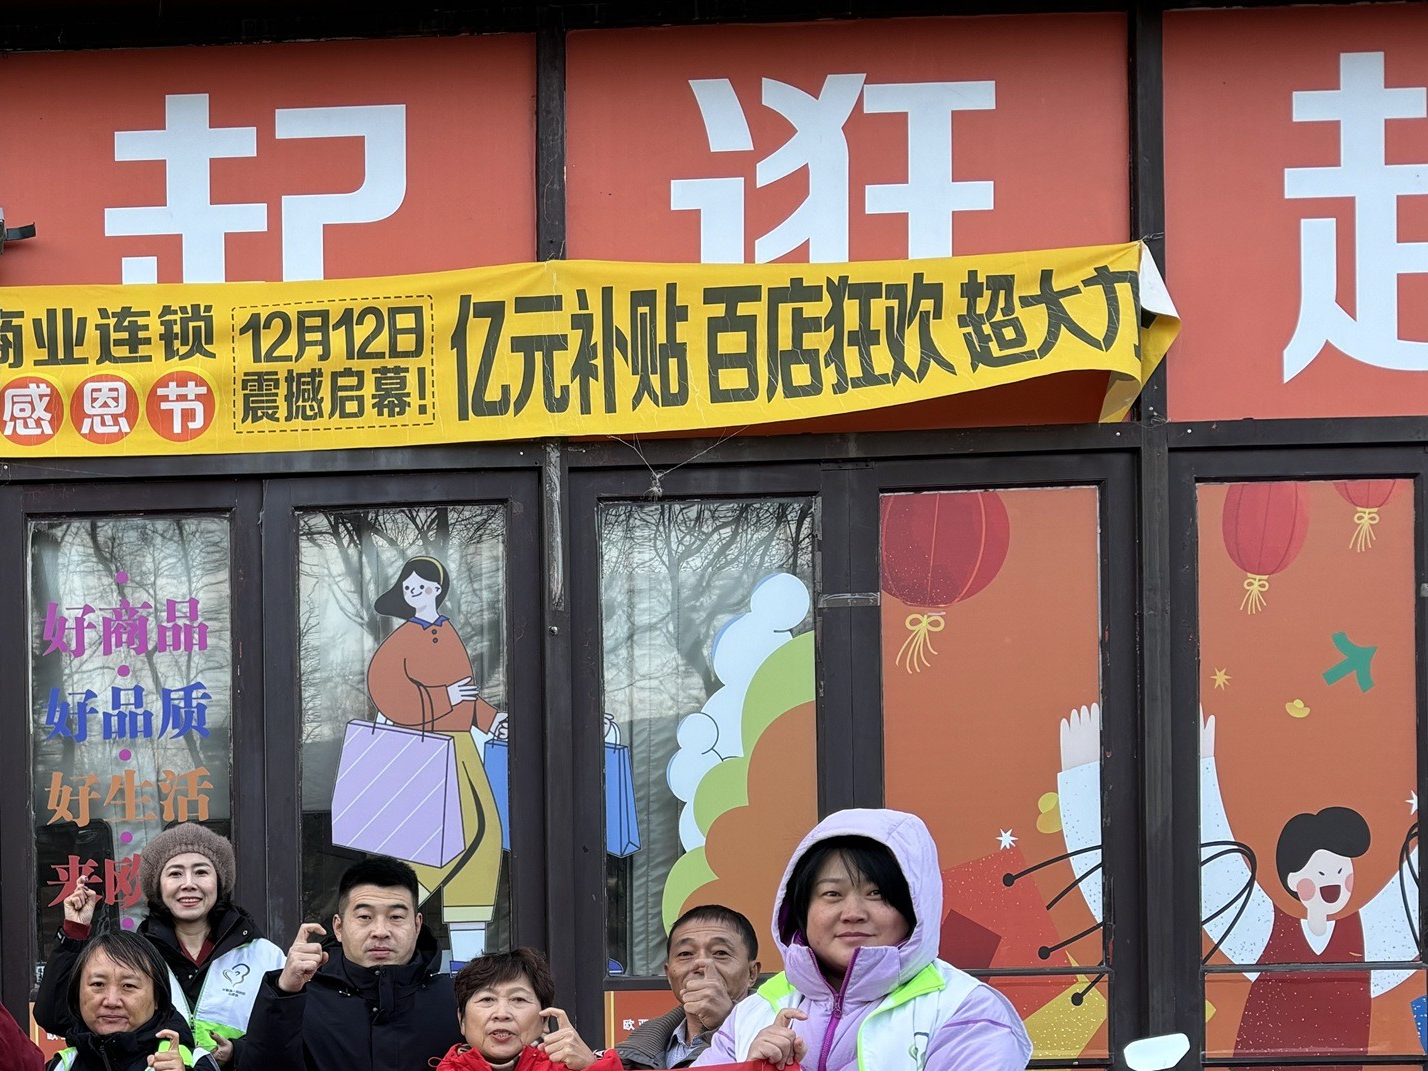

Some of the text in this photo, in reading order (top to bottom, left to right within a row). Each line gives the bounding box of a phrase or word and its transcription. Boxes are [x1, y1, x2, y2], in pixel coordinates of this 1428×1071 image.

[237, 306, 426, 365] 12月12日
[450, 281, 689, 422] 亿元补贴
[702, 272, 959, 405] 百店狂欢
[41, 597, 210, 659] 好商品
[44, 681, 213, 744] 好品质
[45, 766, 214, 829] 好生活
